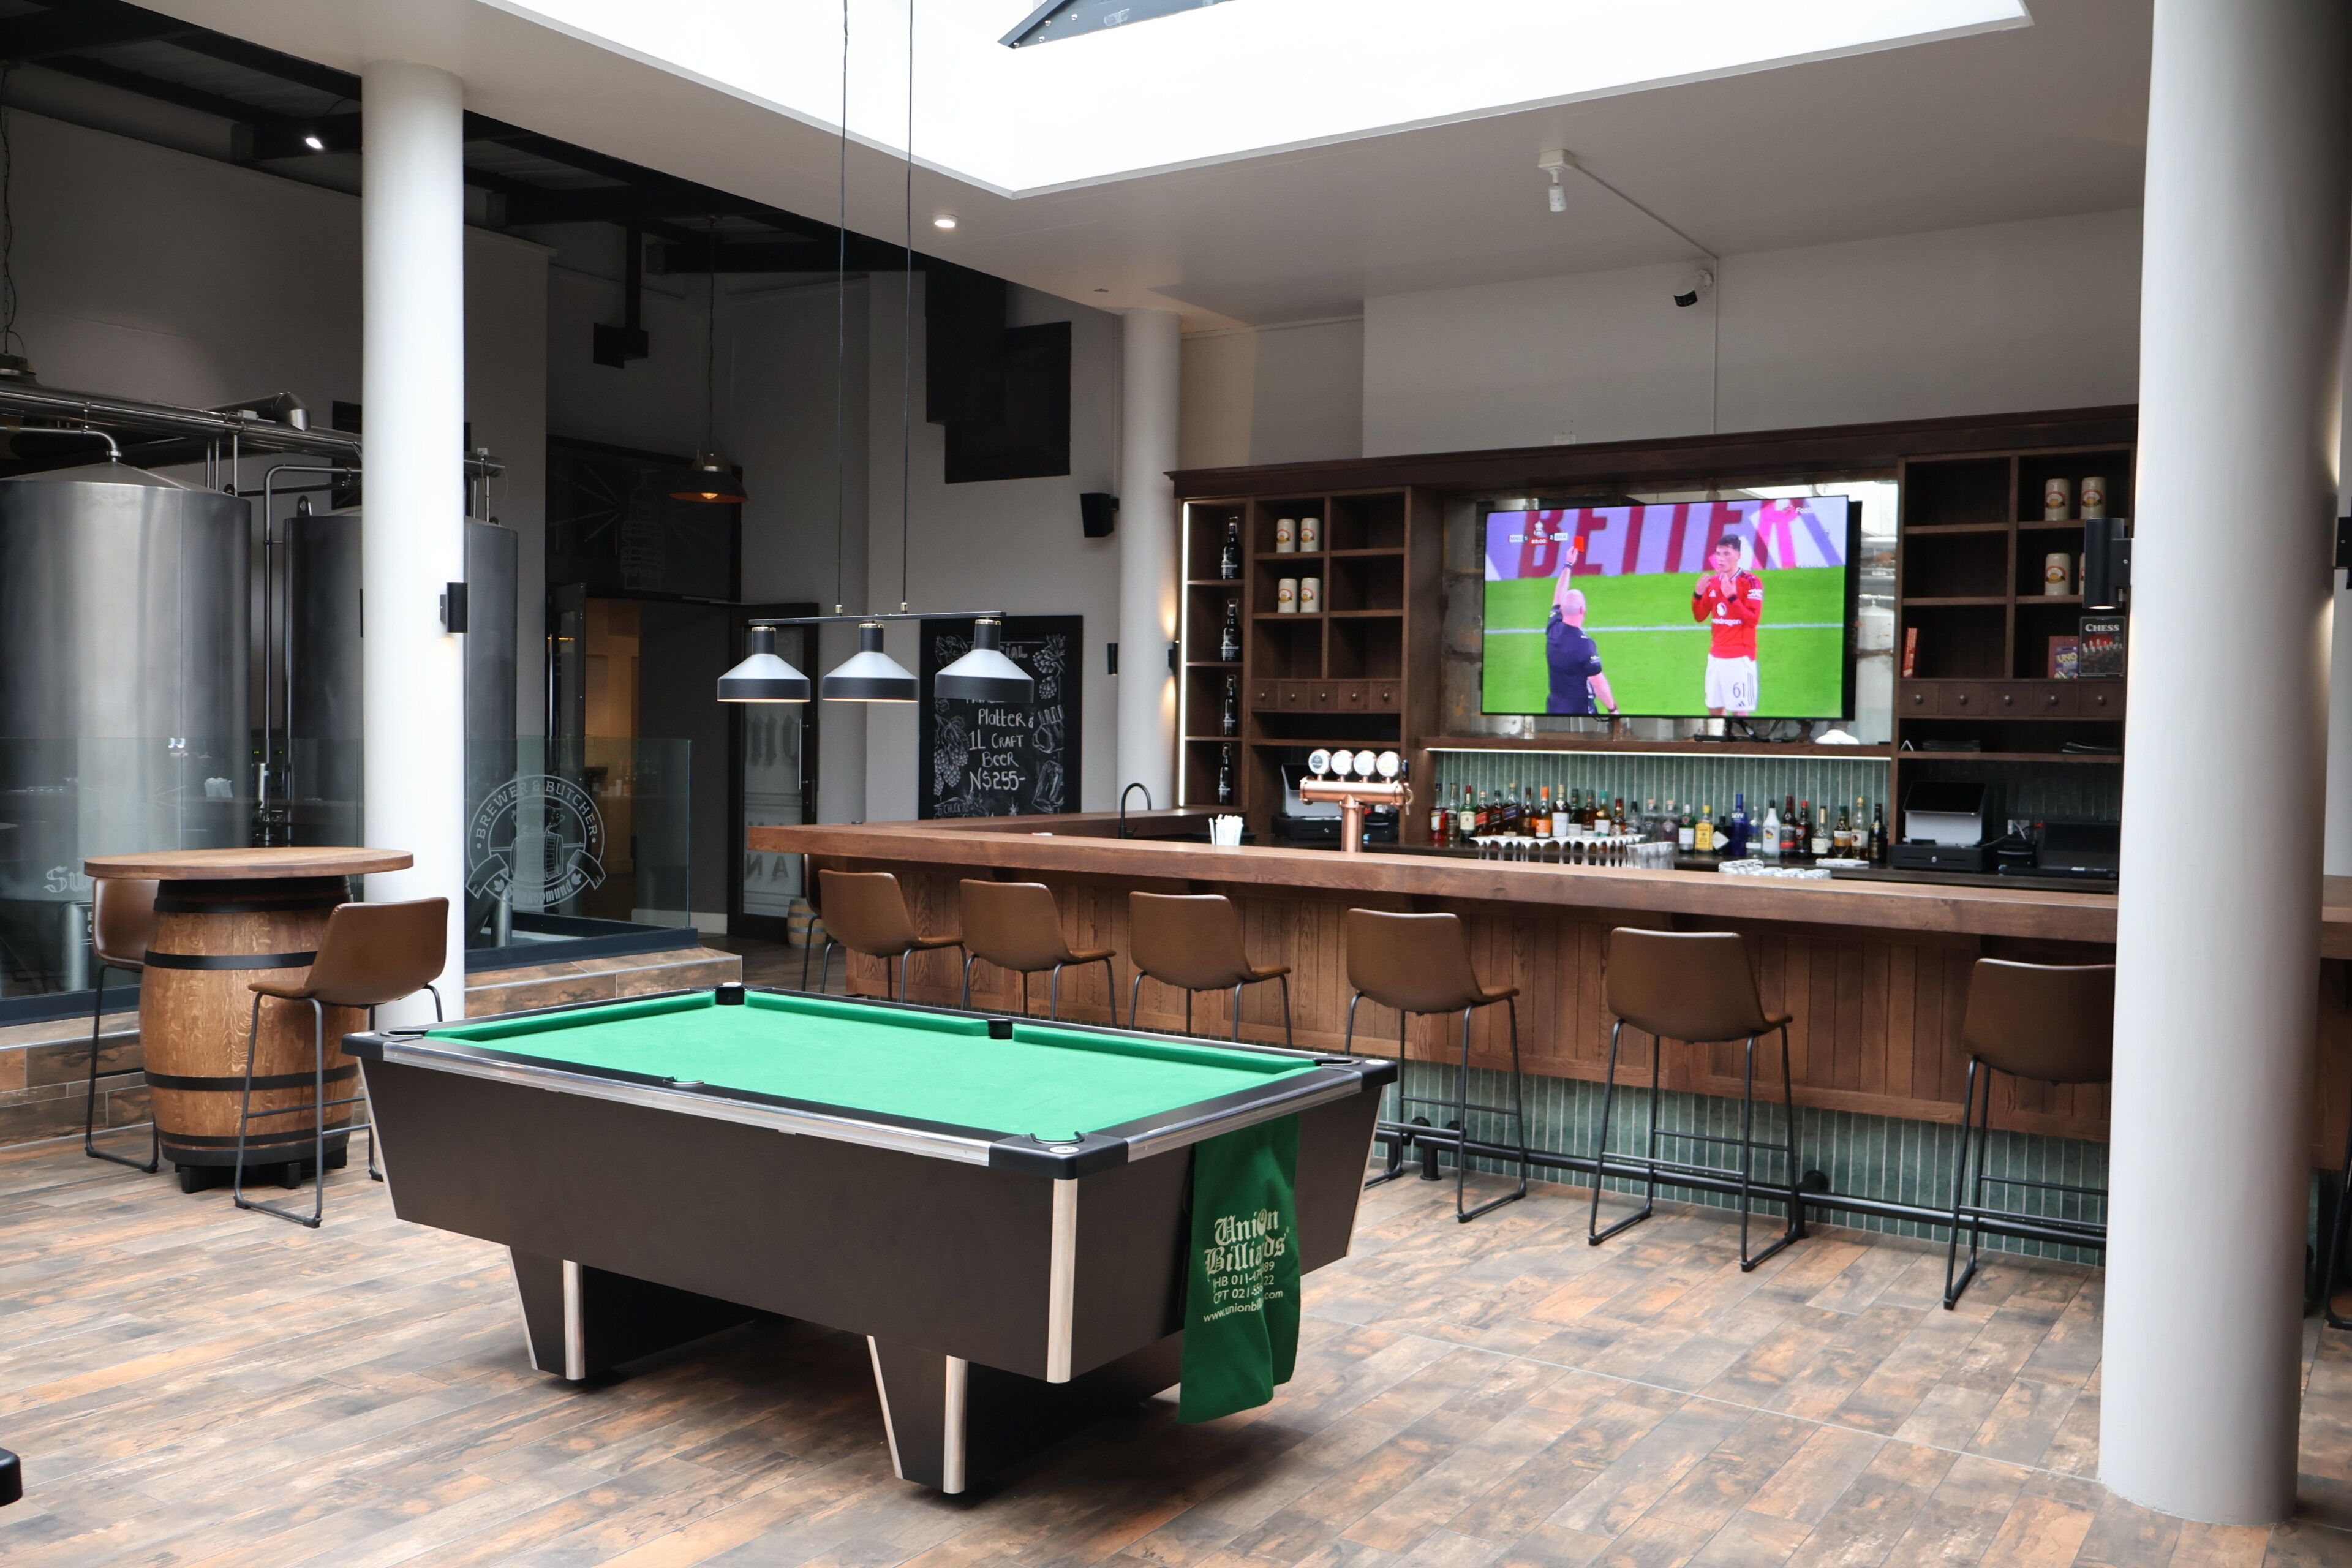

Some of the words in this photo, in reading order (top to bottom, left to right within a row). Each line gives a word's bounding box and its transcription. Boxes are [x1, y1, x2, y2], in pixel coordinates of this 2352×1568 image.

[2085, 624, 2120, 632] CHESS
[2057, 652, 2077, 663] UNO
[1733, 682, 1745, 698] 61
[969, 731, 986, 751] 1L
[475, 782, 527, 840] BREWER
[546, 780, 598, 836] BUTCHER
[1215, 1208, 1280, 1246] Union
[1213, 1289, 1229, 1304] CPT
